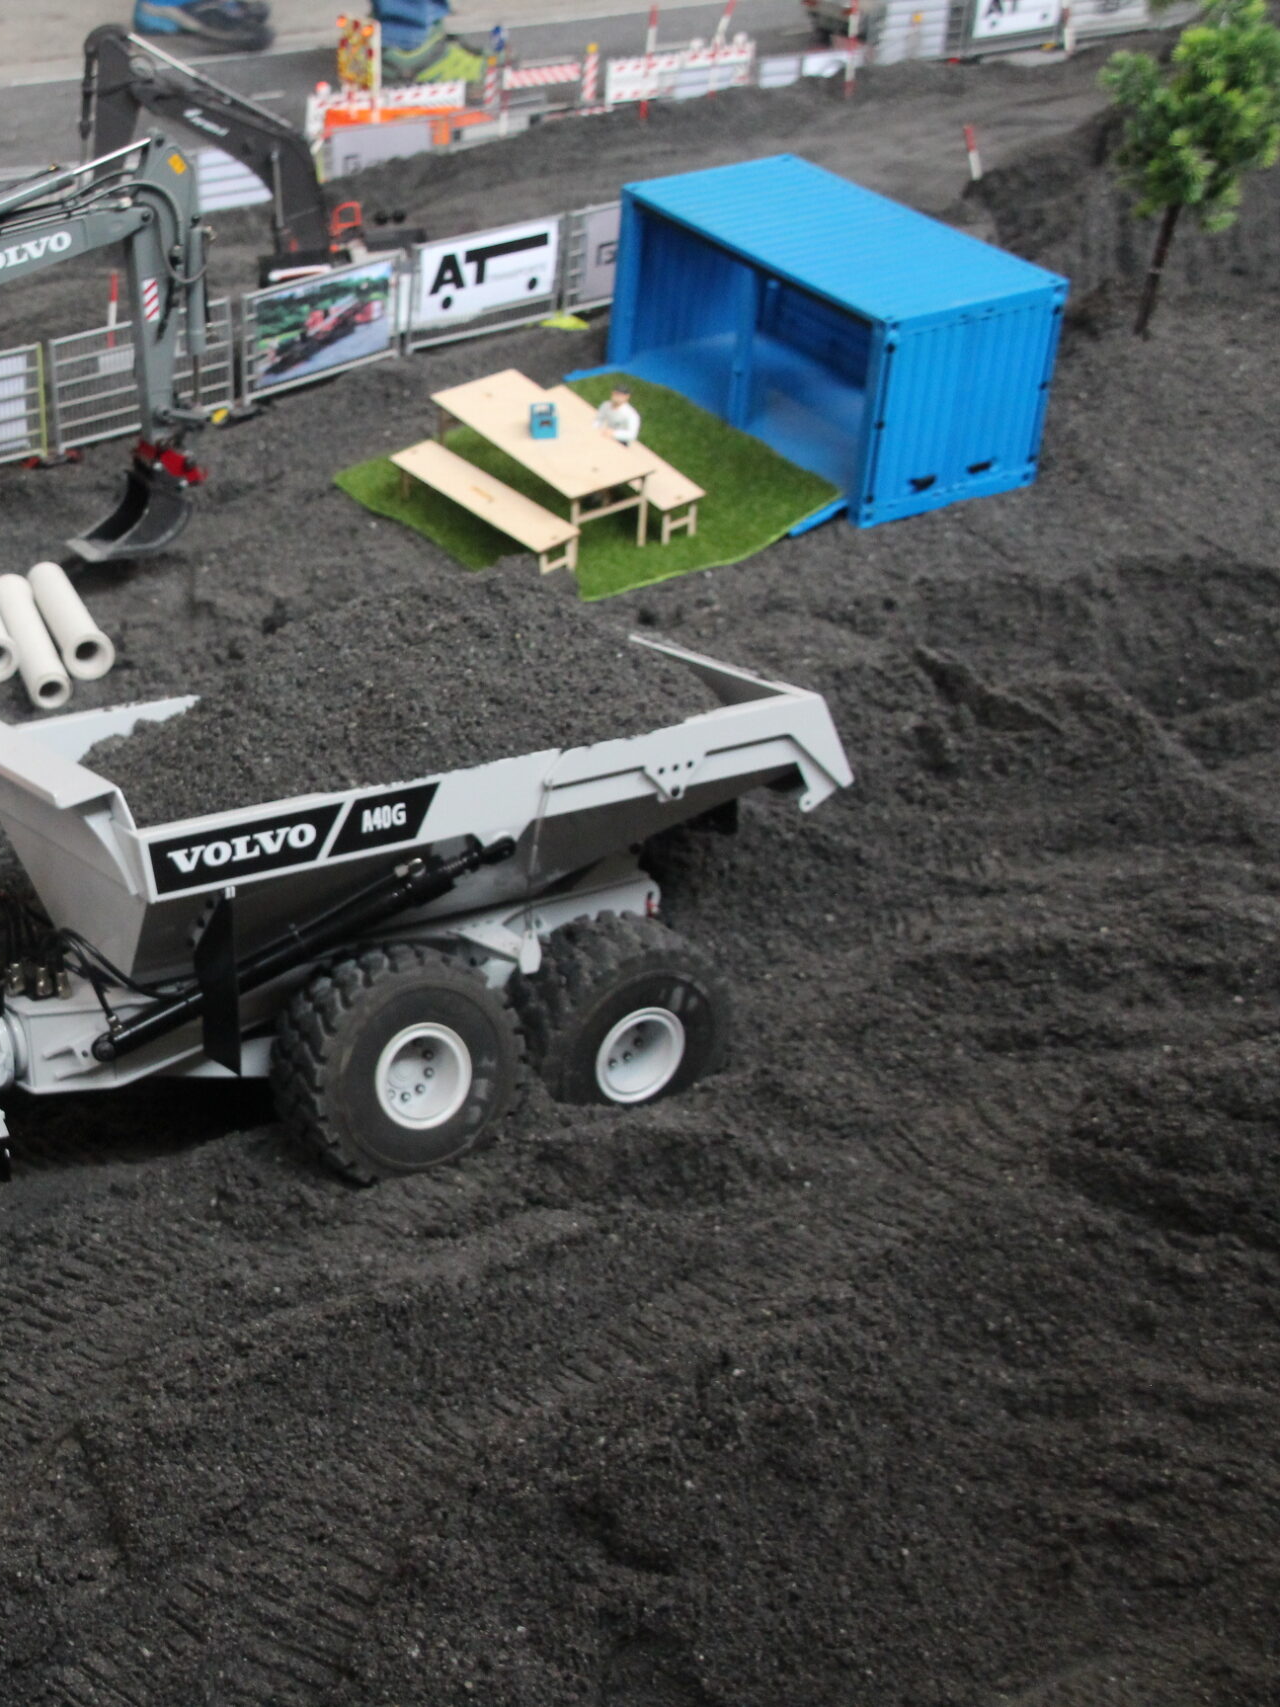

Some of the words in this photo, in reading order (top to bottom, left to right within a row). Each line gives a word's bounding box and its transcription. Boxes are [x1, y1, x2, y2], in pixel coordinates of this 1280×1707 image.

[429, 232, 549, 296] AT
[167, 823, 316, 873] VOLVO
[361, 803, 407, 834] A40G
